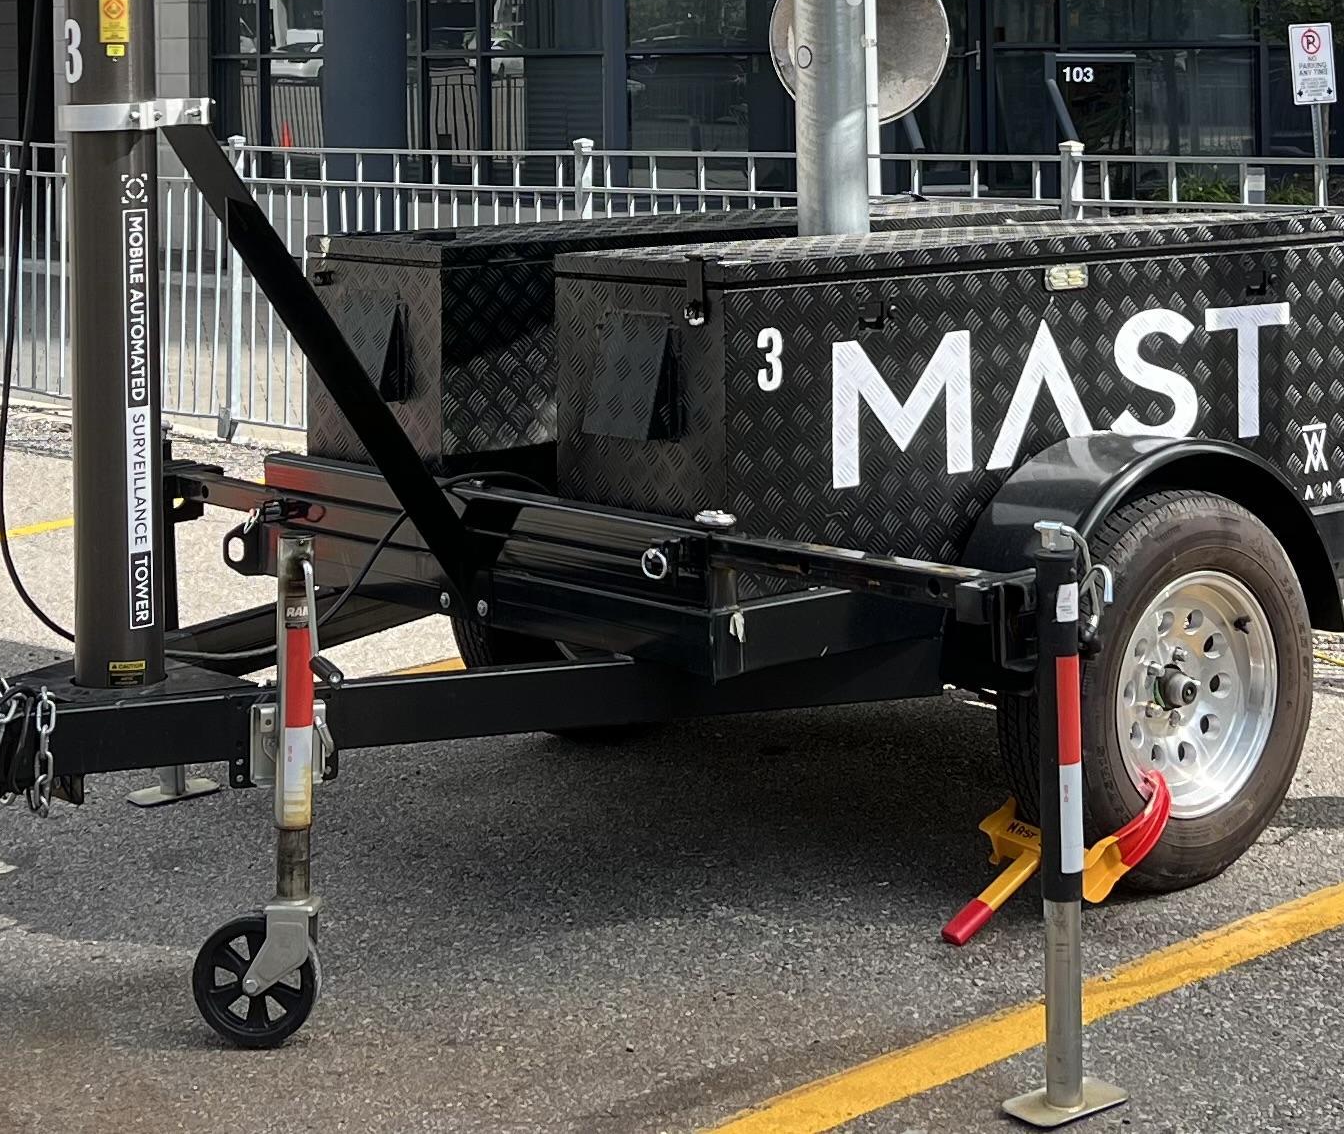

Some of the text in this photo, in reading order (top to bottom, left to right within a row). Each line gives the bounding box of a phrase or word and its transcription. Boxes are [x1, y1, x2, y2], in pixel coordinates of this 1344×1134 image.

[64, 18, 83, 84] 3
[1062, 66, 1094, 82] 103
[757, 327, 783, 392] 3
[128, 216, 149, 622] MOBILE AUTOMATED SURVEILLANCE TOWER
[832, 301, 1290, 489] MAST
